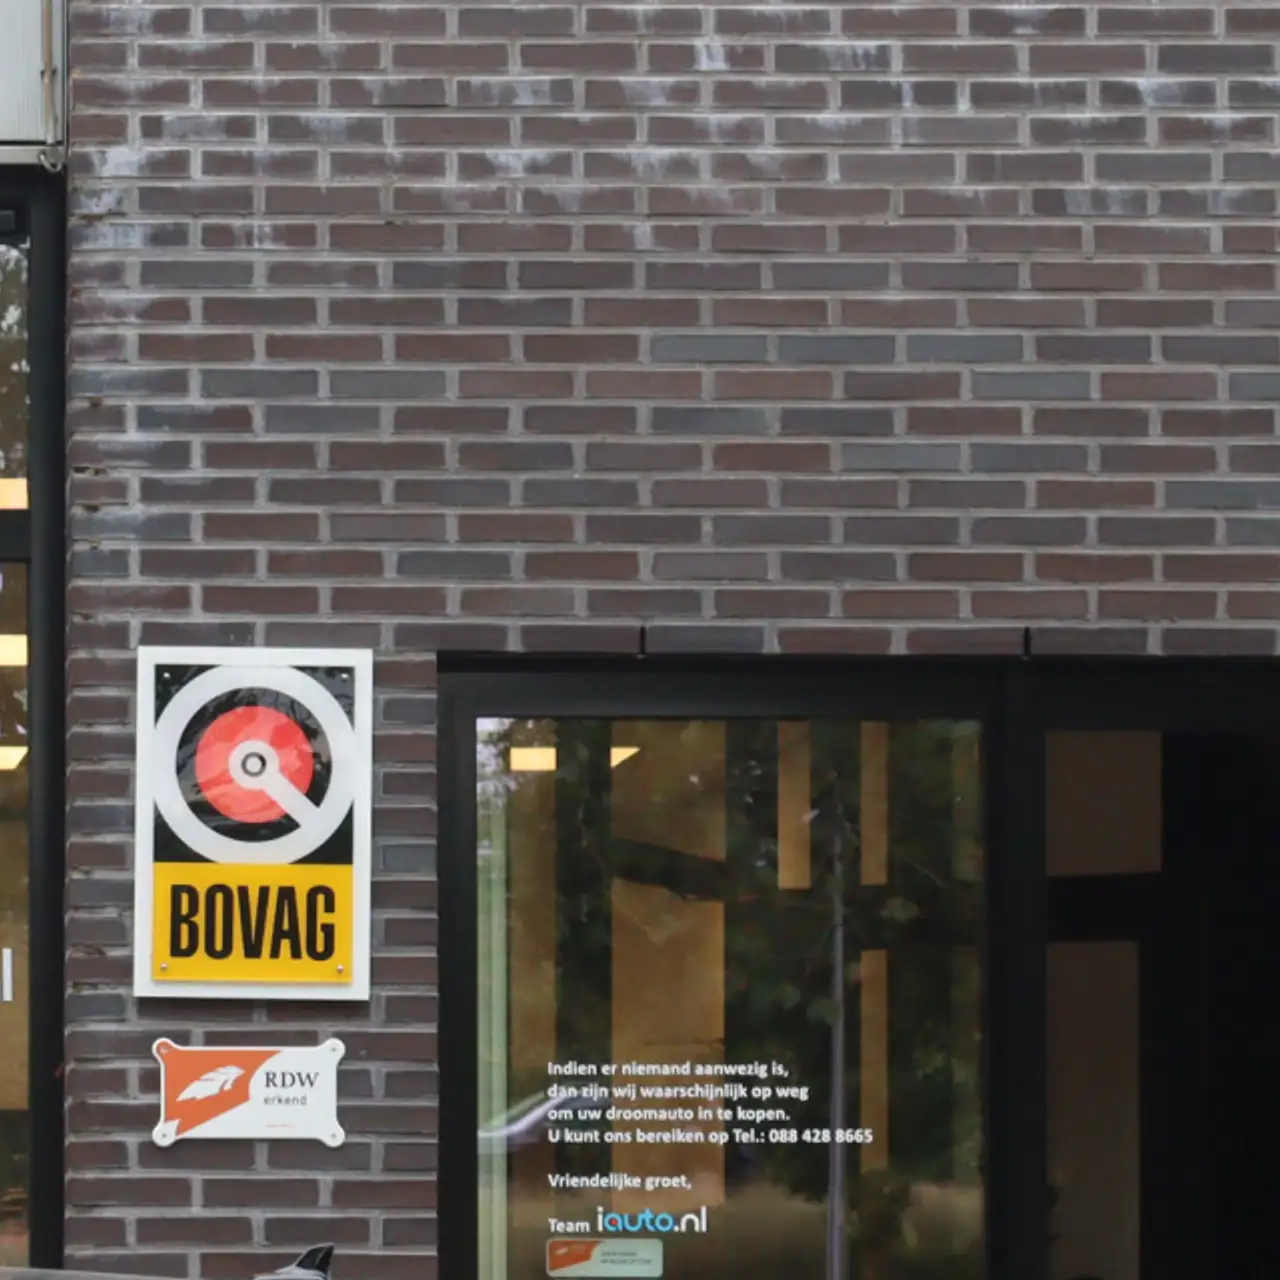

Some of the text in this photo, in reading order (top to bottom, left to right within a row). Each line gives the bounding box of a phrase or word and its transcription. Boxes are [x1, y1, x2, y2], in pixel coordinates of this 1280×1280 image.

[169, 882, 336, 962] BOVAG
[548, 1061, 789, 1079] Indien er niemand aanwezig is,
[265, 1072, 320, 1088] RDW
[264, 1093, 307, 1105] erkend
[547, 1083, 809, 1101] dan zijn wij waarschijnlijk op weg
[547, 1106, 790, 1123] om uw droomauto in te kopen.
[547, 1128, 873, 1145] U kunt ons bereiken op Tel.: 088 428 8665
[548, 1172, 692, 1191] Vriendelijke groet,
[548, 1205, 707, 1232] Team iauto.nl
